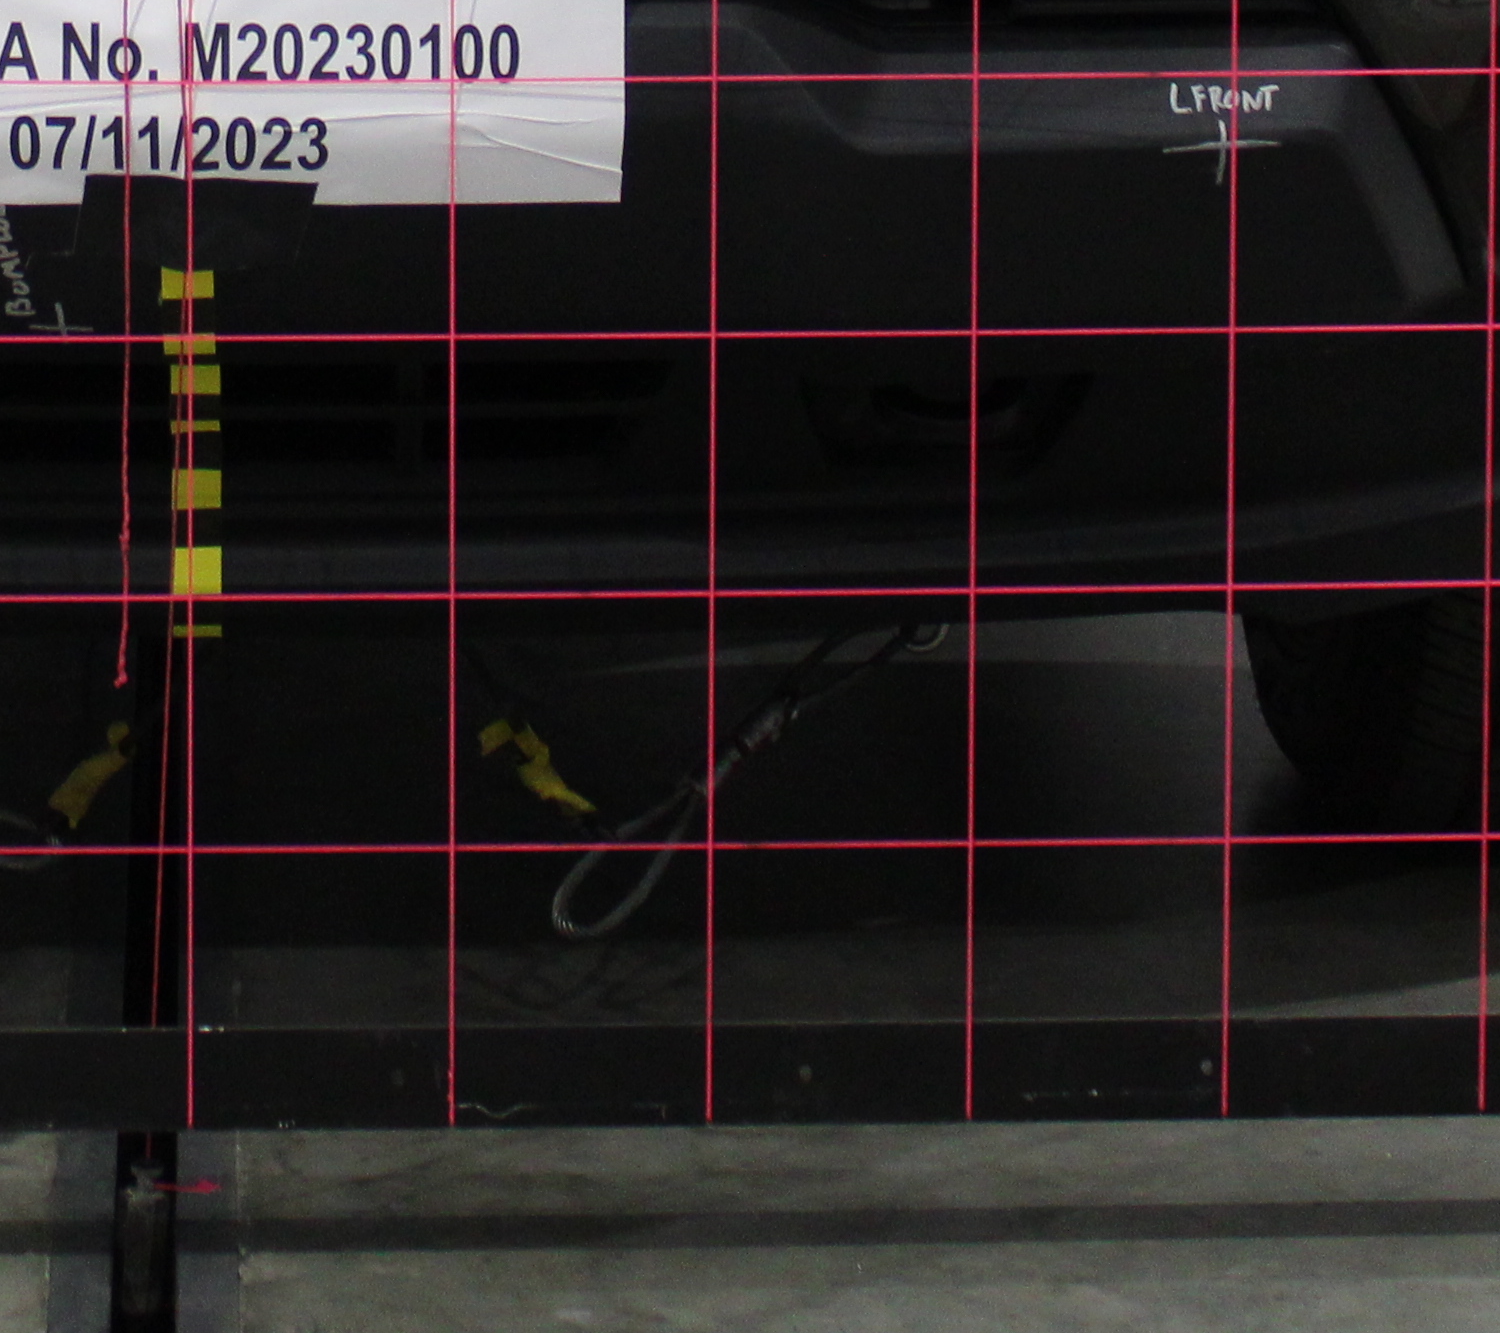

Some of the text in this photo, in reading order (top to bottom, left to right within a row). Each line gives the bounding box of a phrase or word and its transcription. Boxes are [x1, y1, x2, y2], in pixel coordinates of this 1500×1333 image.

[61, 21, 160, 83] No.
[185, 22, 521, 83] M20230100
[9, 115, 330, 174] 07/11/2023
